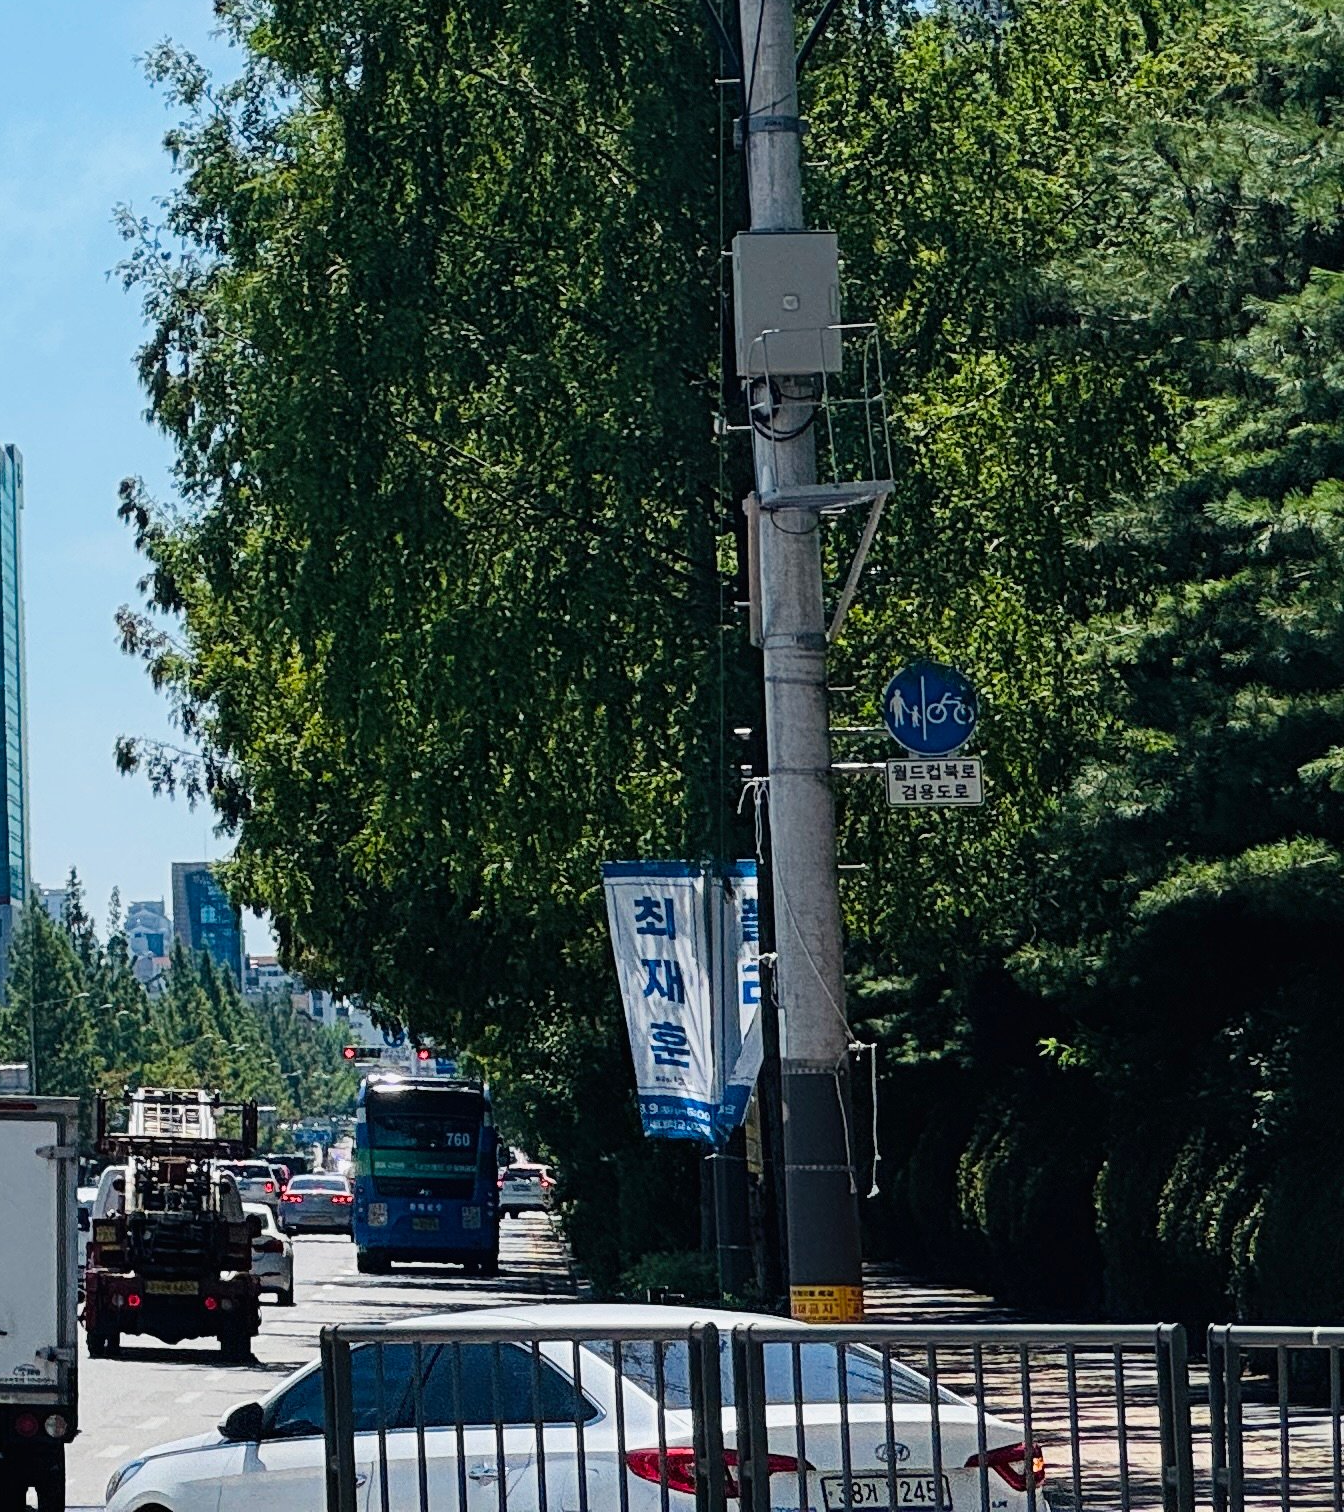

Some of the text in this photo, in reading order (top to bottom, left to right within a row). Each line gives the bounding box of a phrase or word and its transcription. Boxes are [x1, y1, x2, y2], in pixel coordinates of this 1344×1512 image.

[892, 763, 977, 782] 월드컵북로
[902, 783, 970, 801] 겸용도로
[446, 1132, 470, 1147] 760
[885, 1480, 937, 1503] 245
